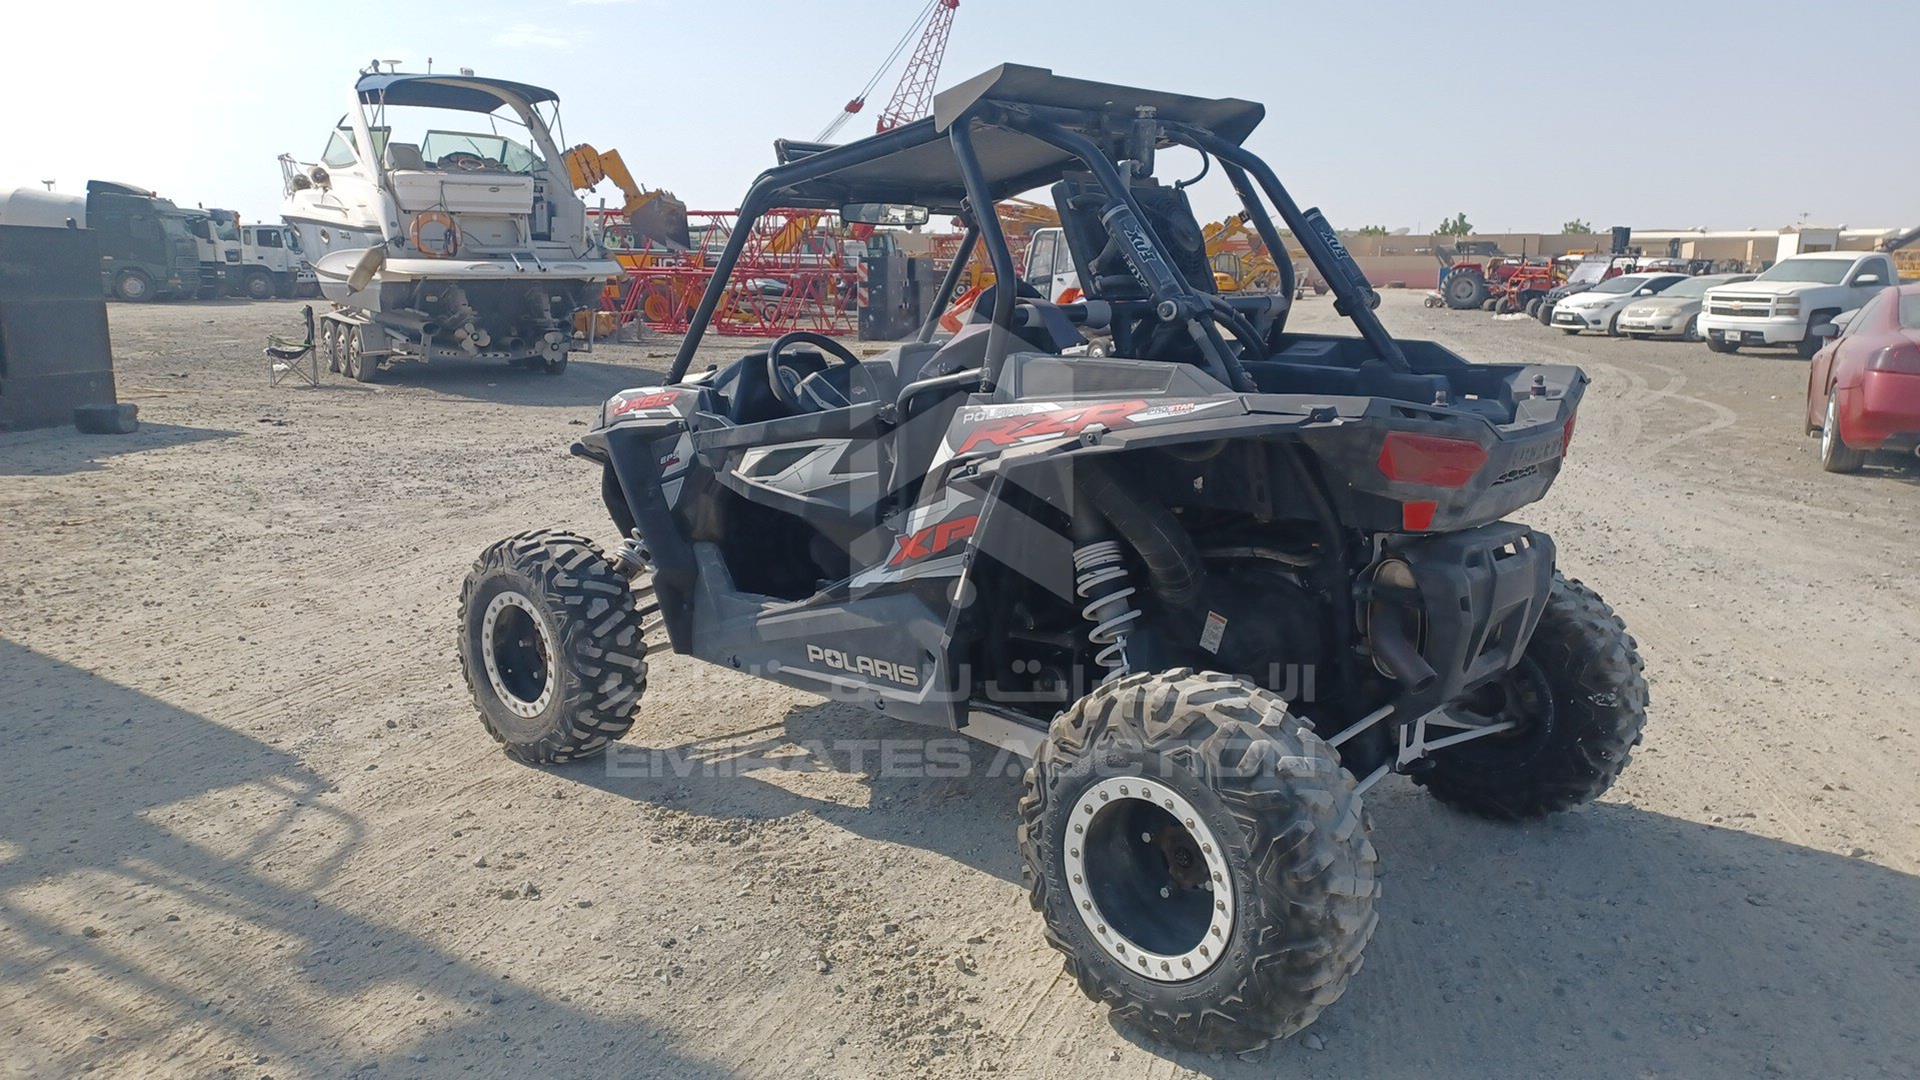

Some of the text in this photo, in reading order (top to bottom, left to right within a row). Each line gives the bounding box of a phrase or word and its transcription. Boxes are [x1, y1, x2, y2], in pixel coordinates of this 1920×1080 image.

[1123, 224, 1157, 263] FOX
[956, 399, 1150, 456] RZR
[888, 515, 979, 567] XP
[806, 644, 919, 686] POLARIS
